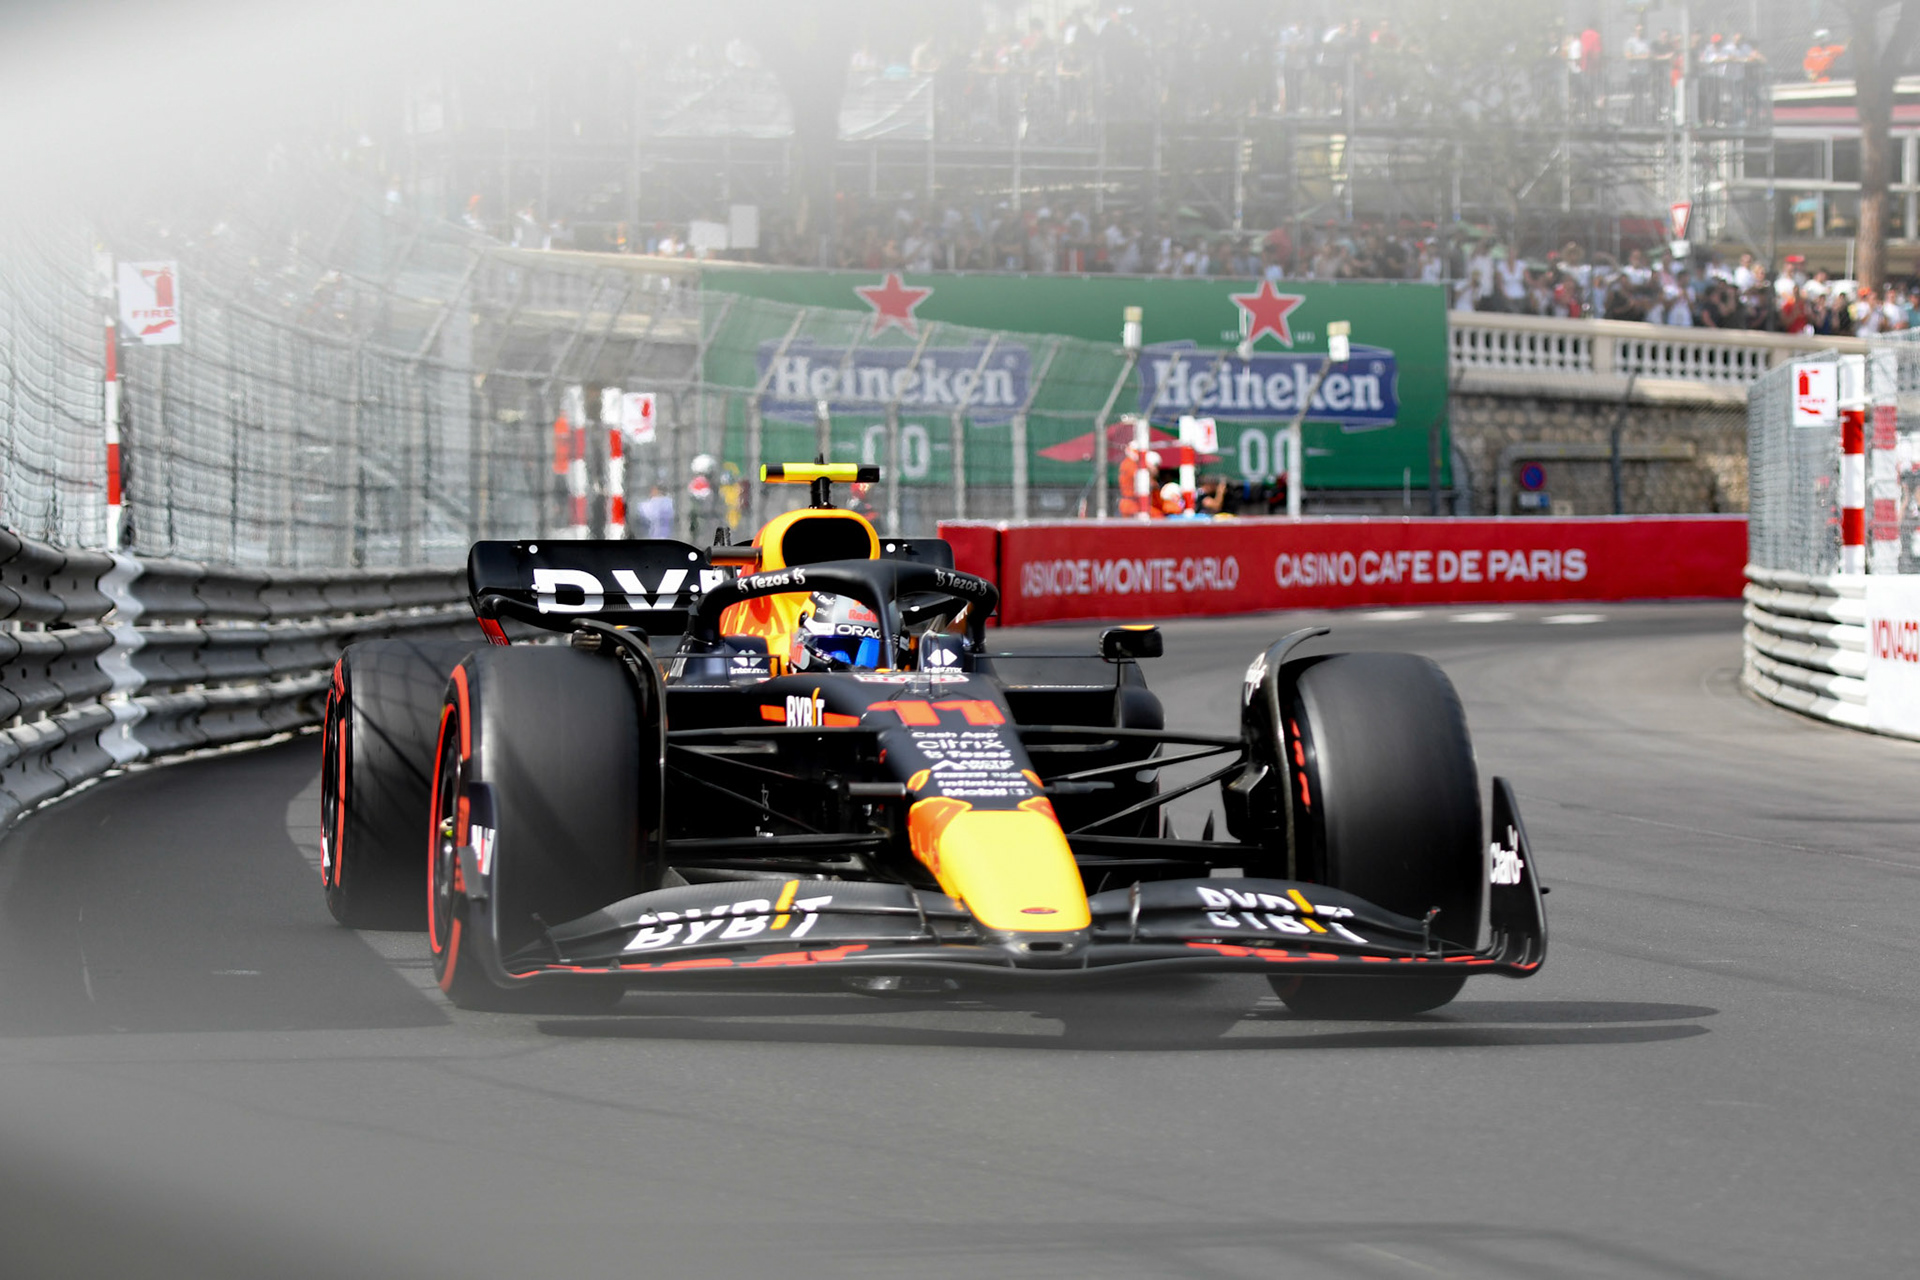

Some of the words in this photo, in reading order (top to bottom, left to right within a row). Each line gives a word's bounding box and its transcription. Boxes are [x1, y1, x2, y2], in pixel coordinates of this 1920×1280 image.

[132, 309, 175, 319] FIRE
[774, 355, 1017, 404] Heineken
[1152, 359, 1385, 411] Heineken
[750, 573, 789, 589] Tezos
[948, 573, 978, 592] Tezos
[1093, 555, 1240, 595] MONTE-CARLO
[1275, 553, 1356, 589] CASINO
[1437, 550, 1482, 583] DE
[1487, 549, 1588, 582] PARIS
[786, 687, 825, 727] BYBIT
[867, 700, 1006, 726] 11
[961, 731, 999, 739] App
